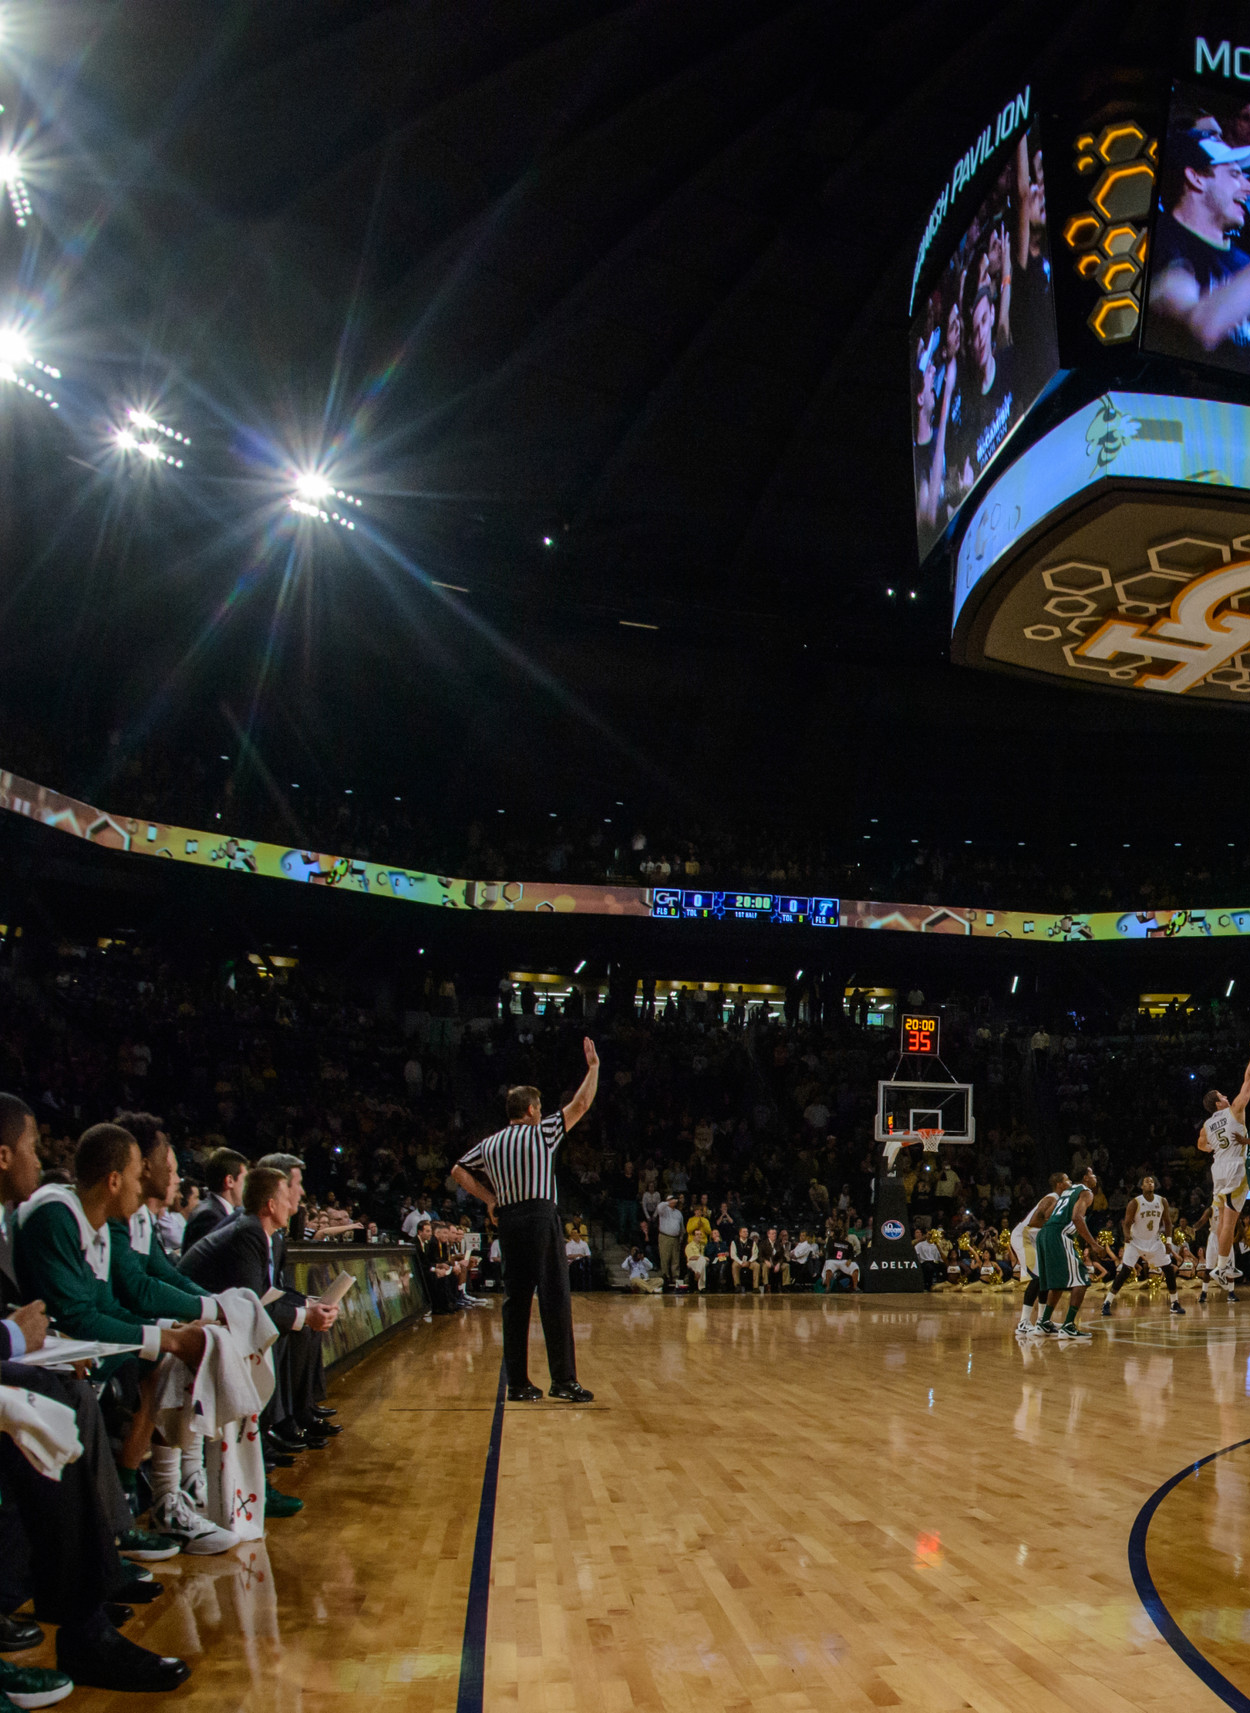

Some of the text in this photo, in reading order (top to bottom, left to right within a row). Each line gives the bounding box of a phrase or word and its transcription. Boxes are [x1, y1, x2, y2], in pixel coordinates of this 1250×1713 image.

[951, 84, 1030, 204] PAVILION
[693, 894, 703, 907] 0
[735, 895, 771, 909] 20:00
[789, 899, 798, 913] 0
[905, 1018, 935, 1031] 20:00
[908, 1030, 931, 1051] 35
[1214, 1128, 1230, 1150] 5
[1146, 1219, 1154, 1232] 4
[881, 1260, 918, 1270] DELTA
